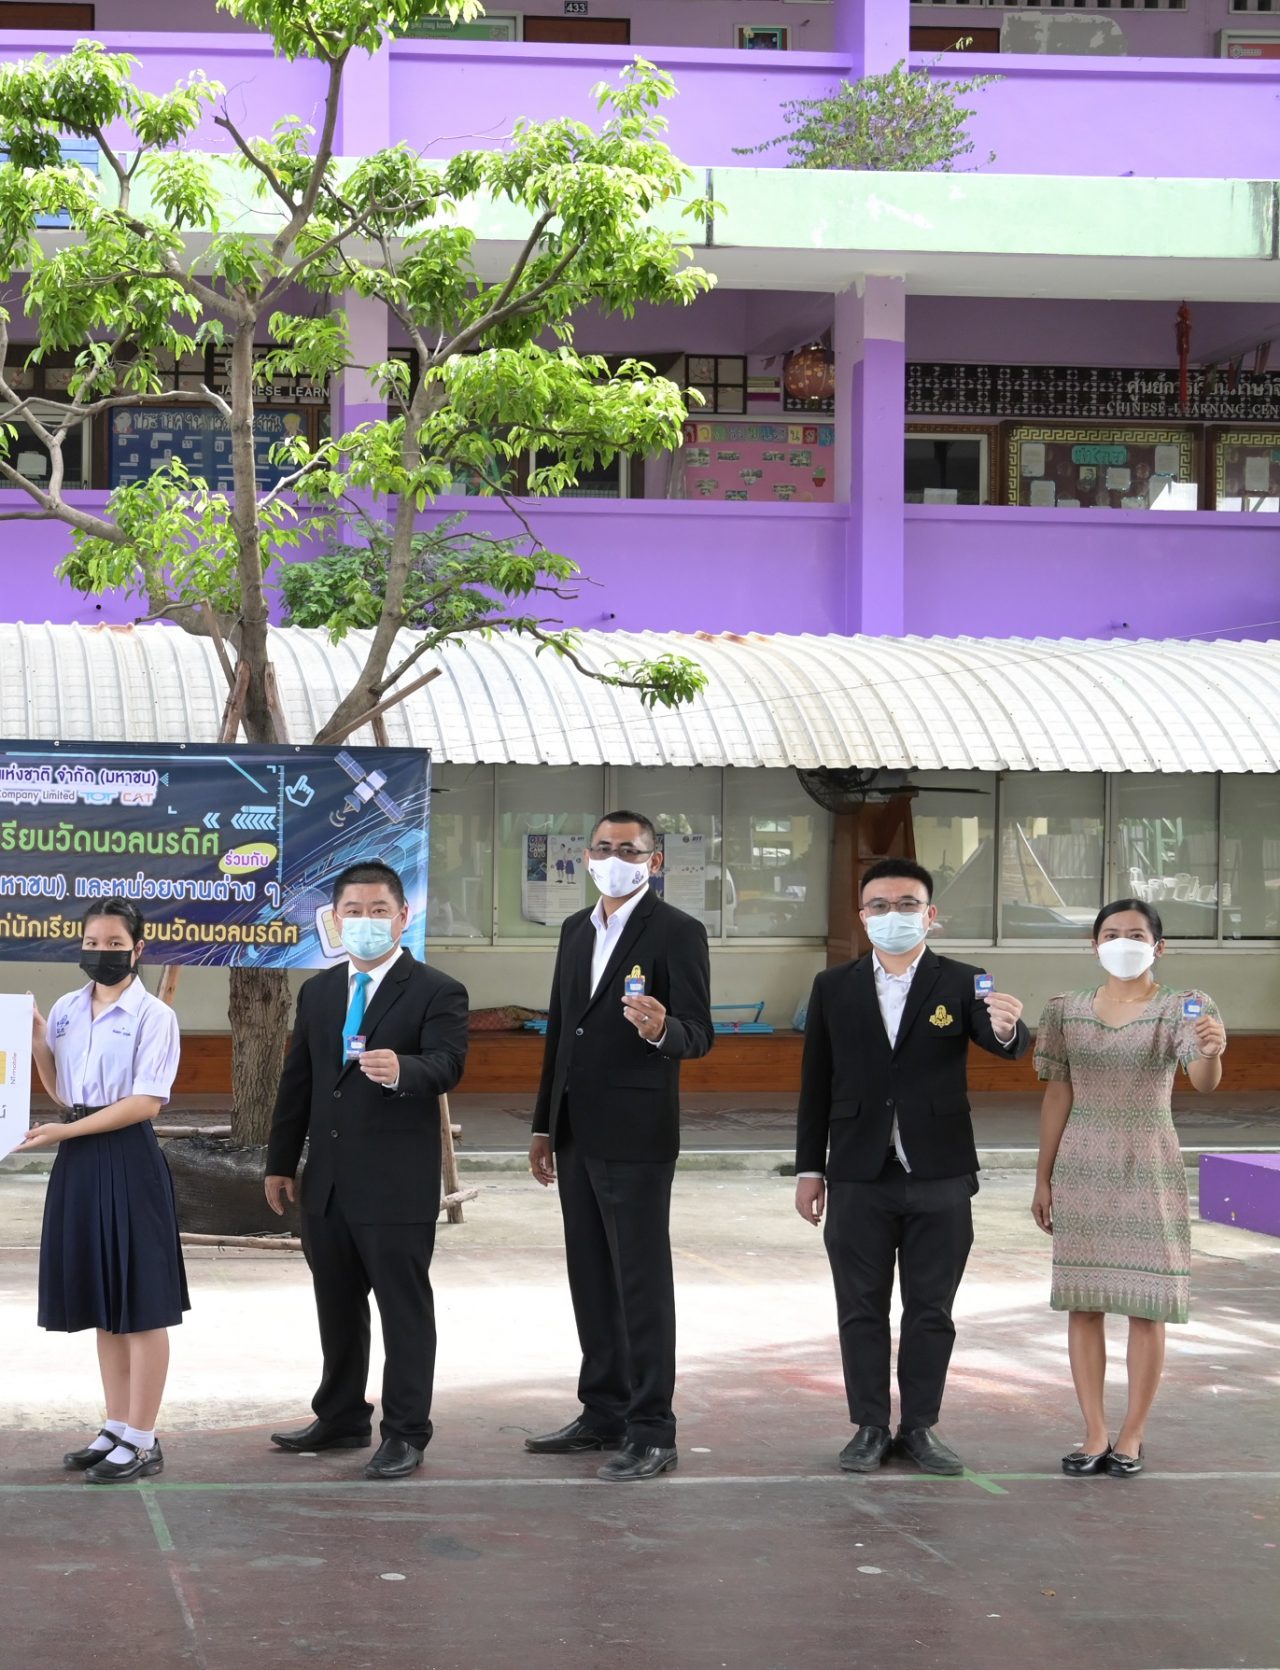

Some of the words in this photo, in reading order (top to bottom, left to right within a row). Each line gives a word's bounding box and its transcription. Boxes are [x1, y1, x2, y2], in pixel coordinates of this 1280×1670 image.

[566, 4, 586, 13] 433
[218, 386, 281, 397] JANESE
[1173, 403, 1245, 415] LARNING
[56, 765, 95, 784] จำกัด
[100, 768, 157, 786] (มหาชน)
[42, 790, 75, 801] Limited
[224, 851, 270, 868] ร่วมกับ
[75, 872, 256, 902] และหน่วยงานต่าง
